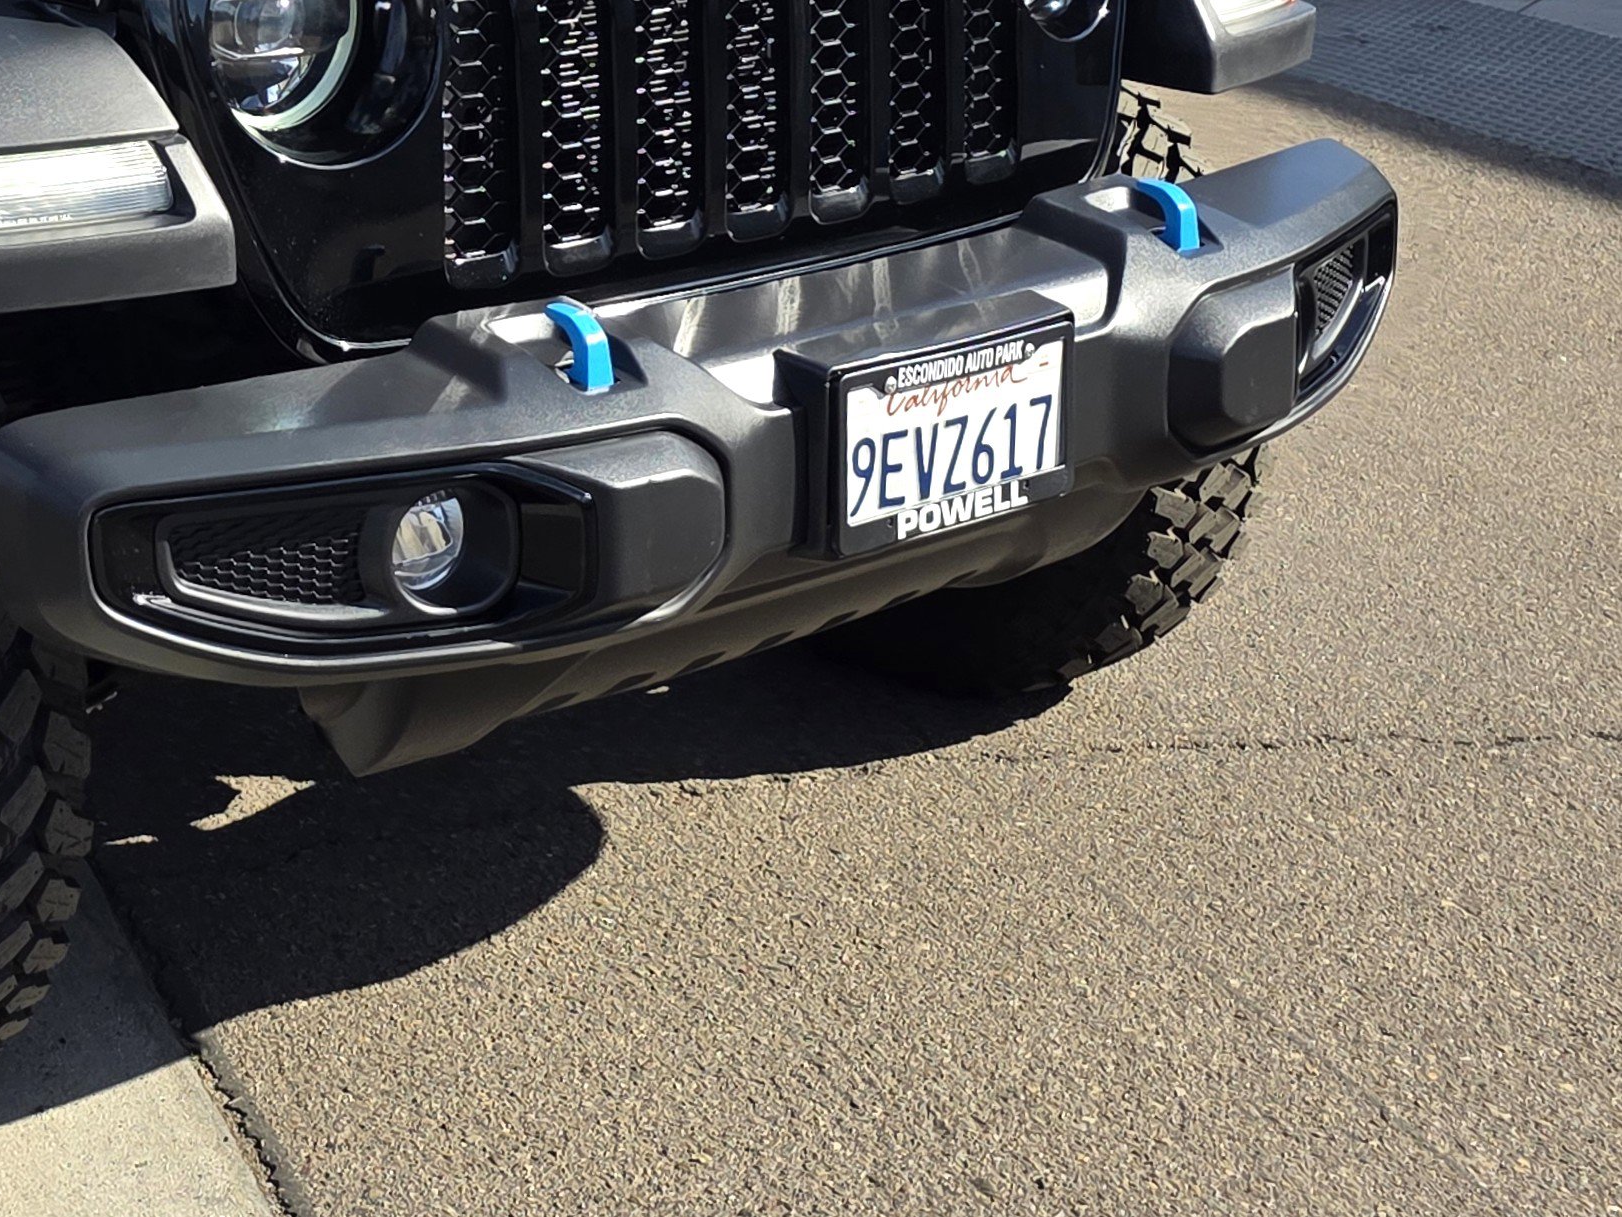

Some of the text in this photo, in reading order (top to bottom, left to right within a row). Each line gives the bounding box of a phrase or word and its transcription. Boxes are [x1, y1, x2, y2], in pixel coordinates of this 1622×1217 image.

[886, 364, 1028, 416] California
[897, 339, 1026, 389] ESCONDIDO AUTO PARK
[849, 394, 1054, 518] 9EVZ617
[896, 481, 1029, 541] POWELL
